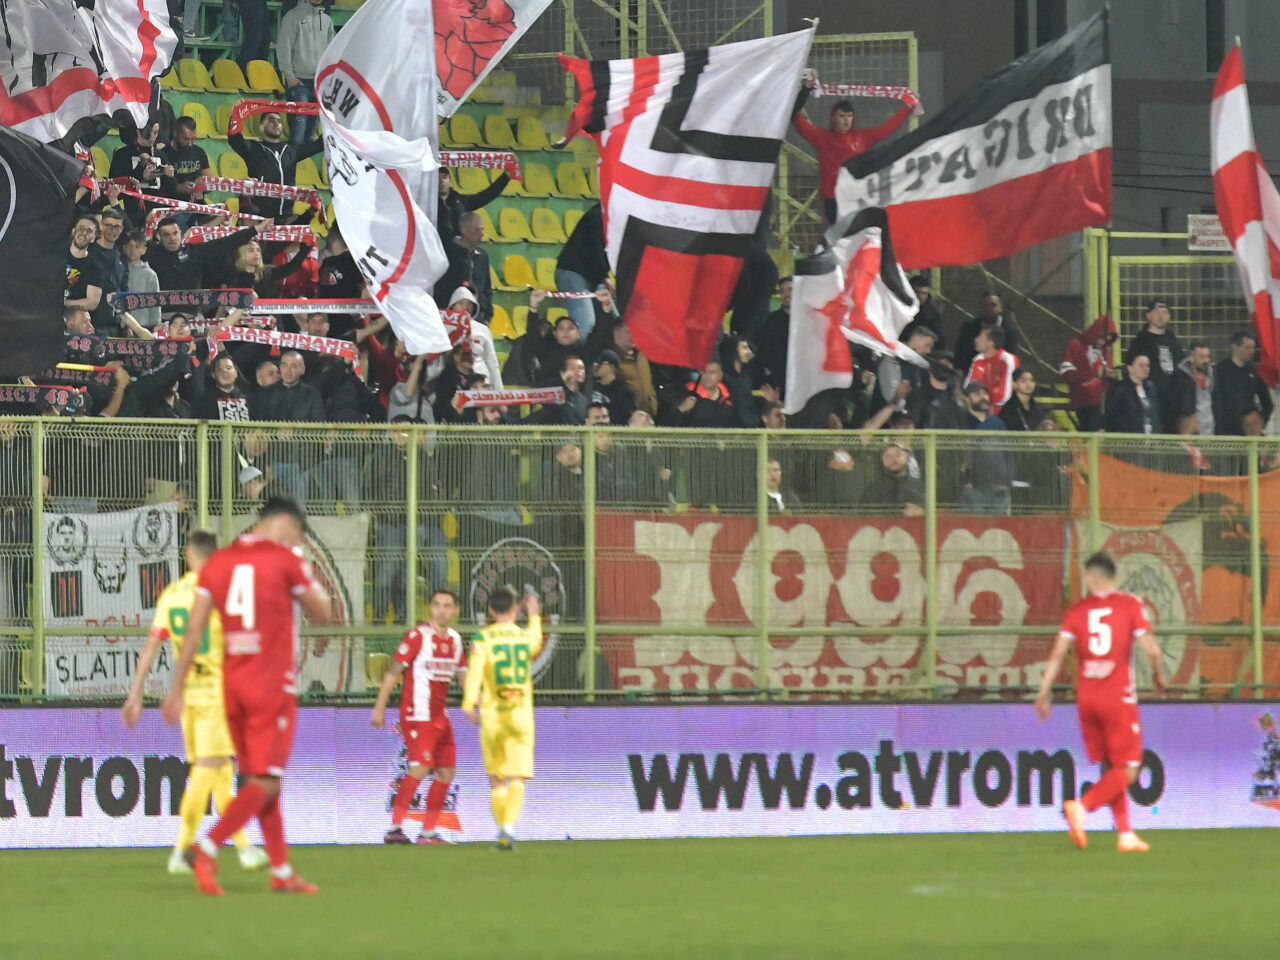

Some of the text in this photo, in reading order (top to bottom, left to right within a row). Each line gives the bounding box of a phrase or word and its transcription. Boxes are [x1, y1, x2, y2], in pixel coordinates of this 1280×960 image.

[45, 388, 69, 405] 48
[218, 400, 249, 412] FCK
[225, 563, 255, 630] 4
[1087, 607, 1113, 657] 5
[492, 644, 532, 685] 28
[628, 740, 1165, 812] www.atvrom.o
